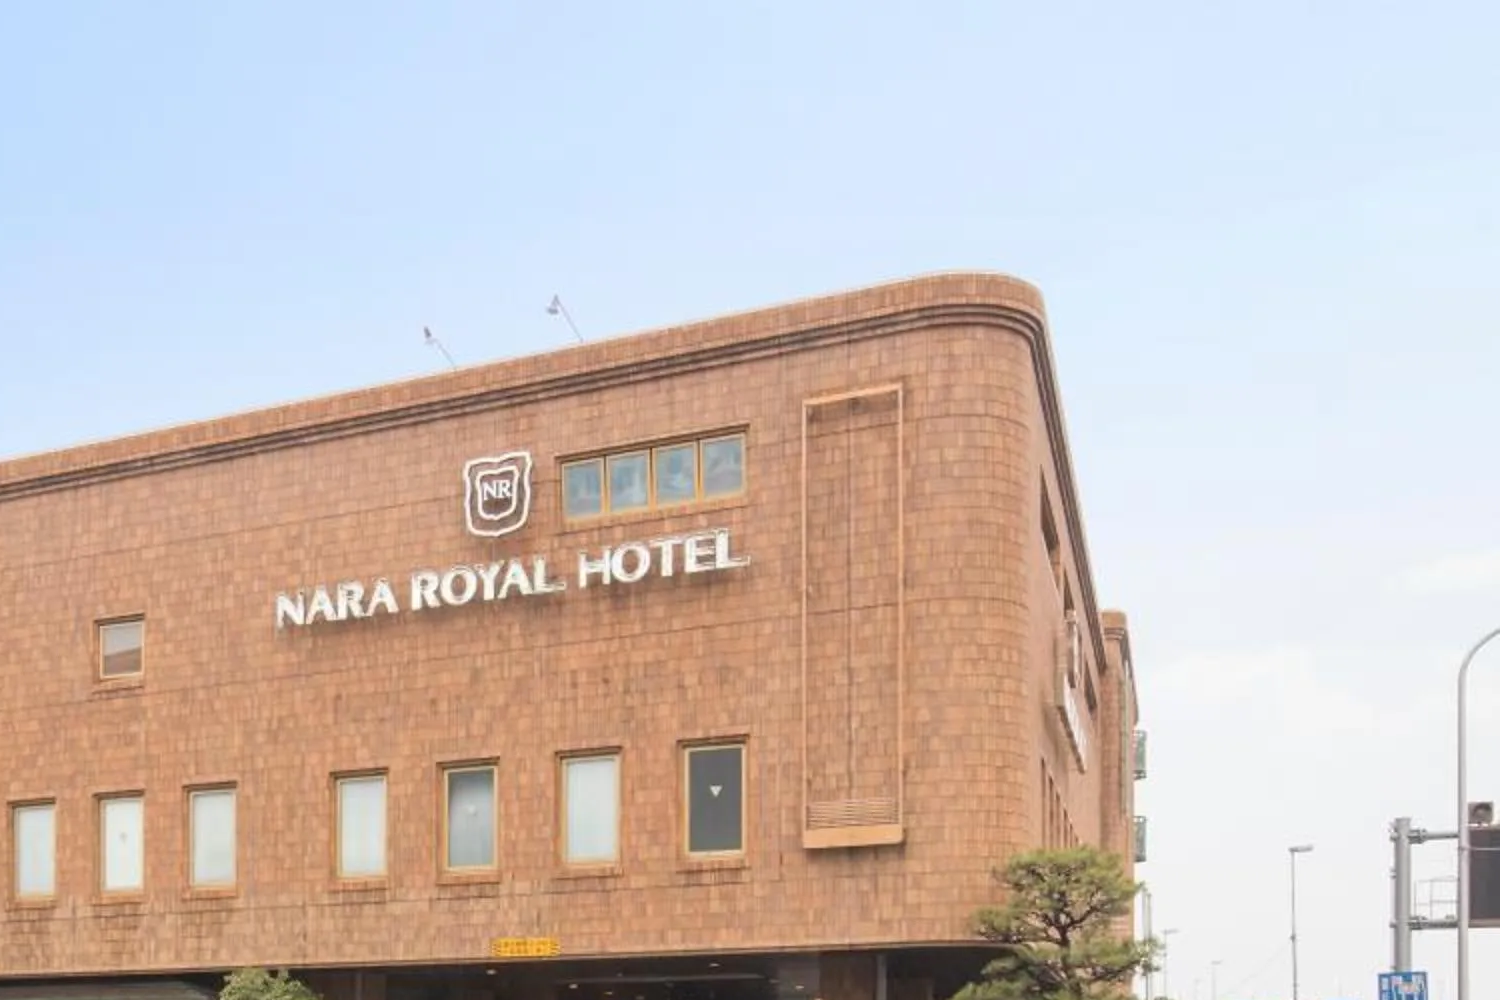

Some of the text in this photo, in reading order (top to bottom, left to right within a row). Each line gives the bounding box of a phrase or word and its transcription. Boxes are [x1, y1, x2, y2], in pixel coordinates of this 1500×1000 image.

[482, 478, 512, 501] NR
[275, 528, 751, 630] NARA ROYAL HOTEL
